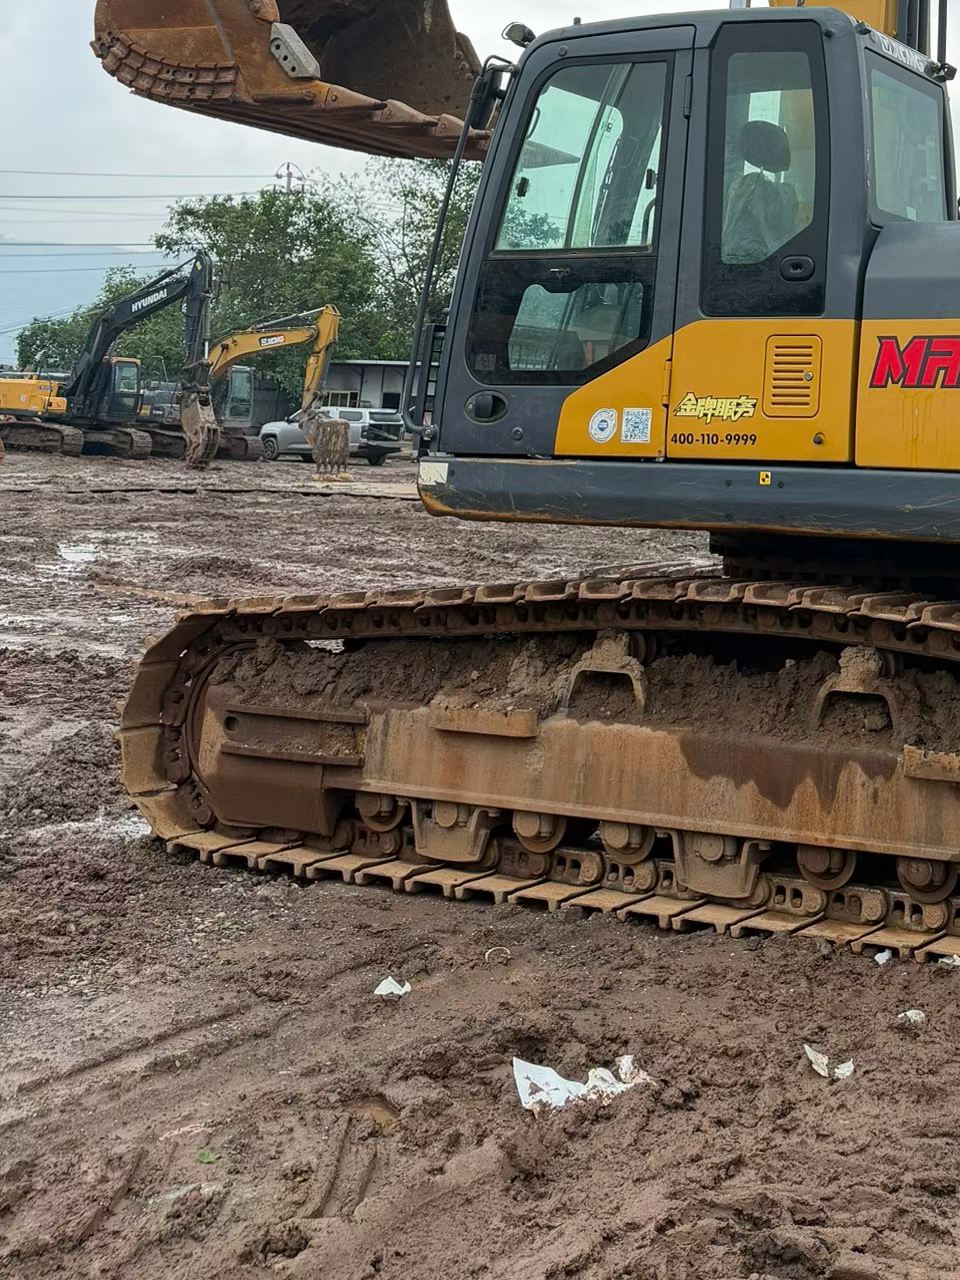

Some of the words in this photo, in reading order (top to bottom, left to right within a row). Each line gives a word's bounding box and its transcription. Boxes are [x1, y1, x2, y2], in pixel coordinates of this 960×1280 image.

[131, 288, 168, 313] HYUNDAI
[673, 392, 758, 424] 金牌服务
[670, 432, 758, 446] 400-110-9999
